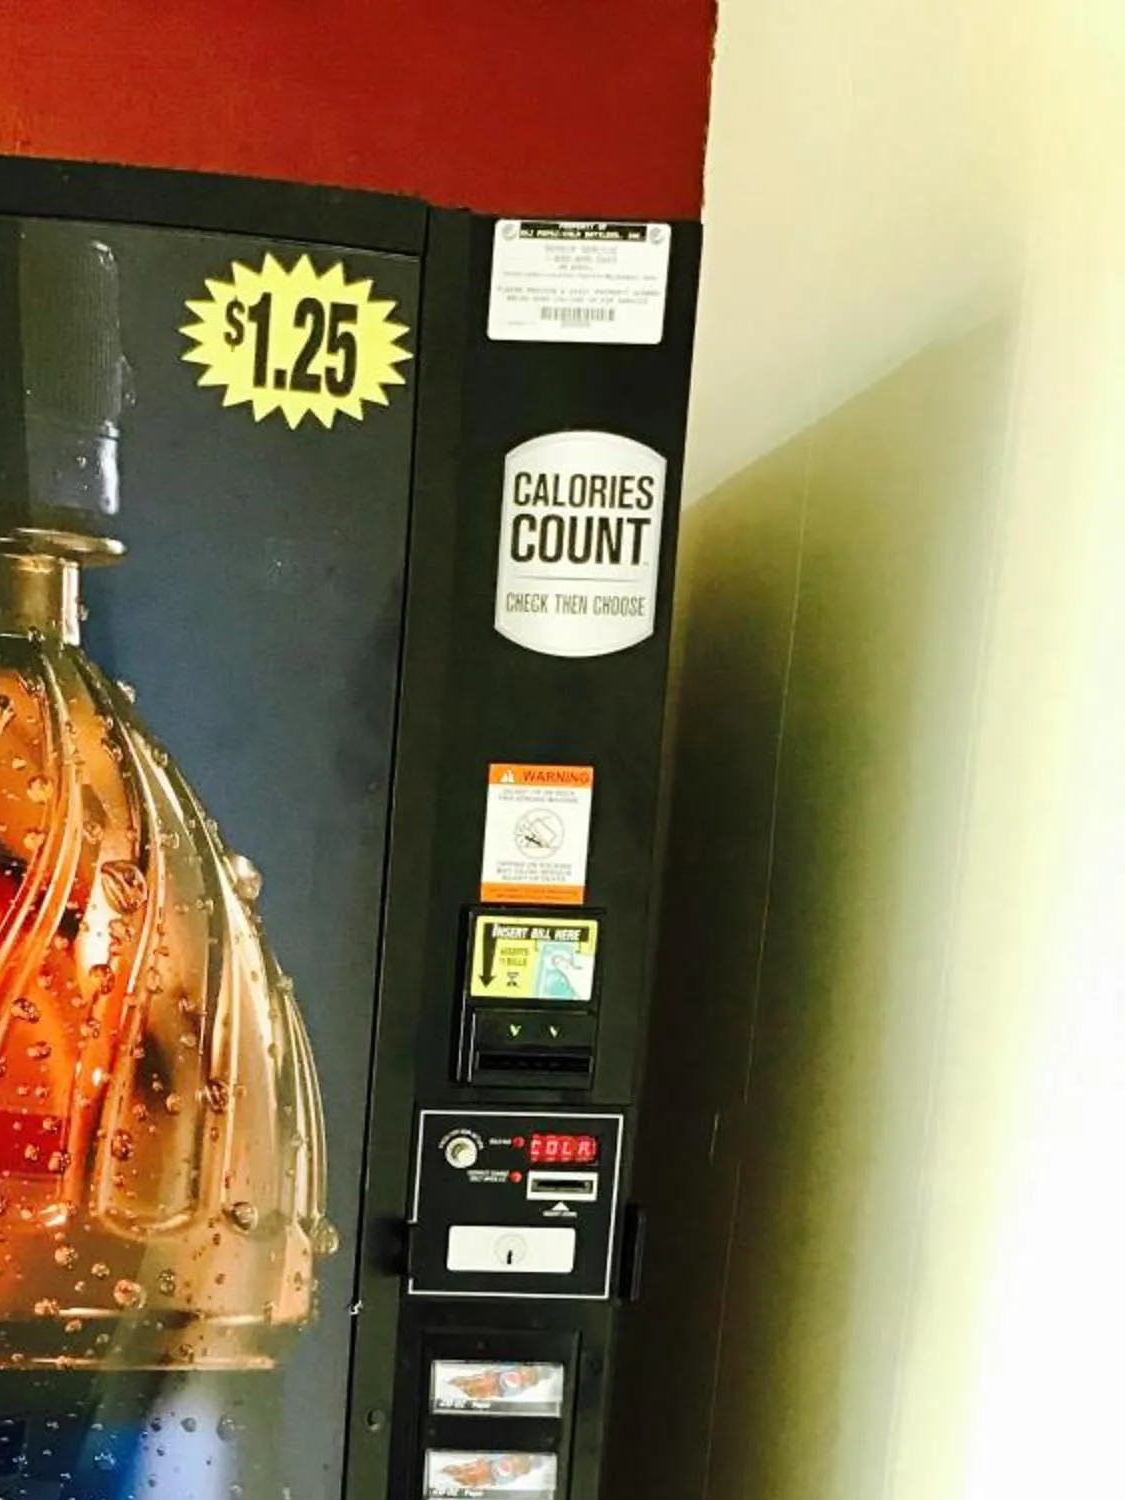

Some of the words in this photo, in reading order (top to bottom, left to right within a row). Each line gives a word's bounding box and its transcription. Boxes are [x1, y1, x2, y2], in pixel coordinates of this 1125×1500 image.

[223, 291, 359, 398] $1.25
[512, 471, 655, 511] CALORIES
[510, 513, 652, 566] COUNT
[506, 591, 548, 614] CHECK
[555, 593, 588, 615] THEN
[593, 594, 647, 618] CHOOSE
[522, 769, 591, 785] WARNING
[492, 922, 529, 940] INSERT
[555, 929, 582, 942] HERE
